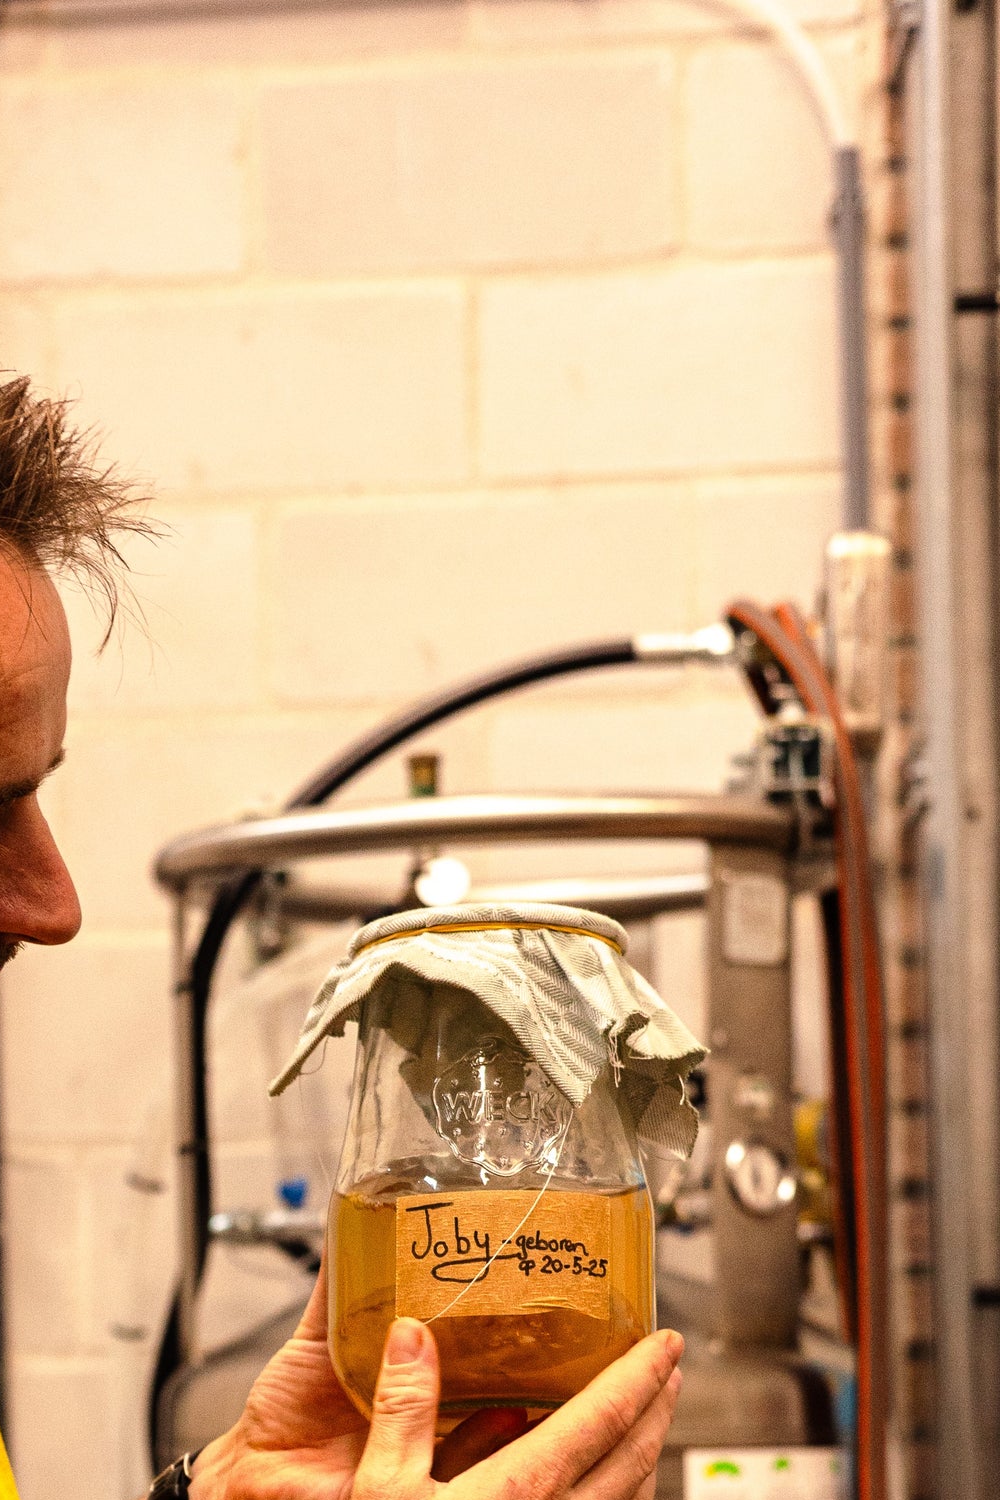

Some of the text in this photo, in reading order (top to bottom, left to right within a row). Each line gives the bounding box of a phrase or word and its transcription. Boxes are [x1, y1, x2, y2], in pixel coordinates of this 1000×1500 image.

[442, 1090, 556, 1123] WECK
[406, 1202, 490, 1283] Joby
[540, 1255, 609, 1278] 20-5-25
